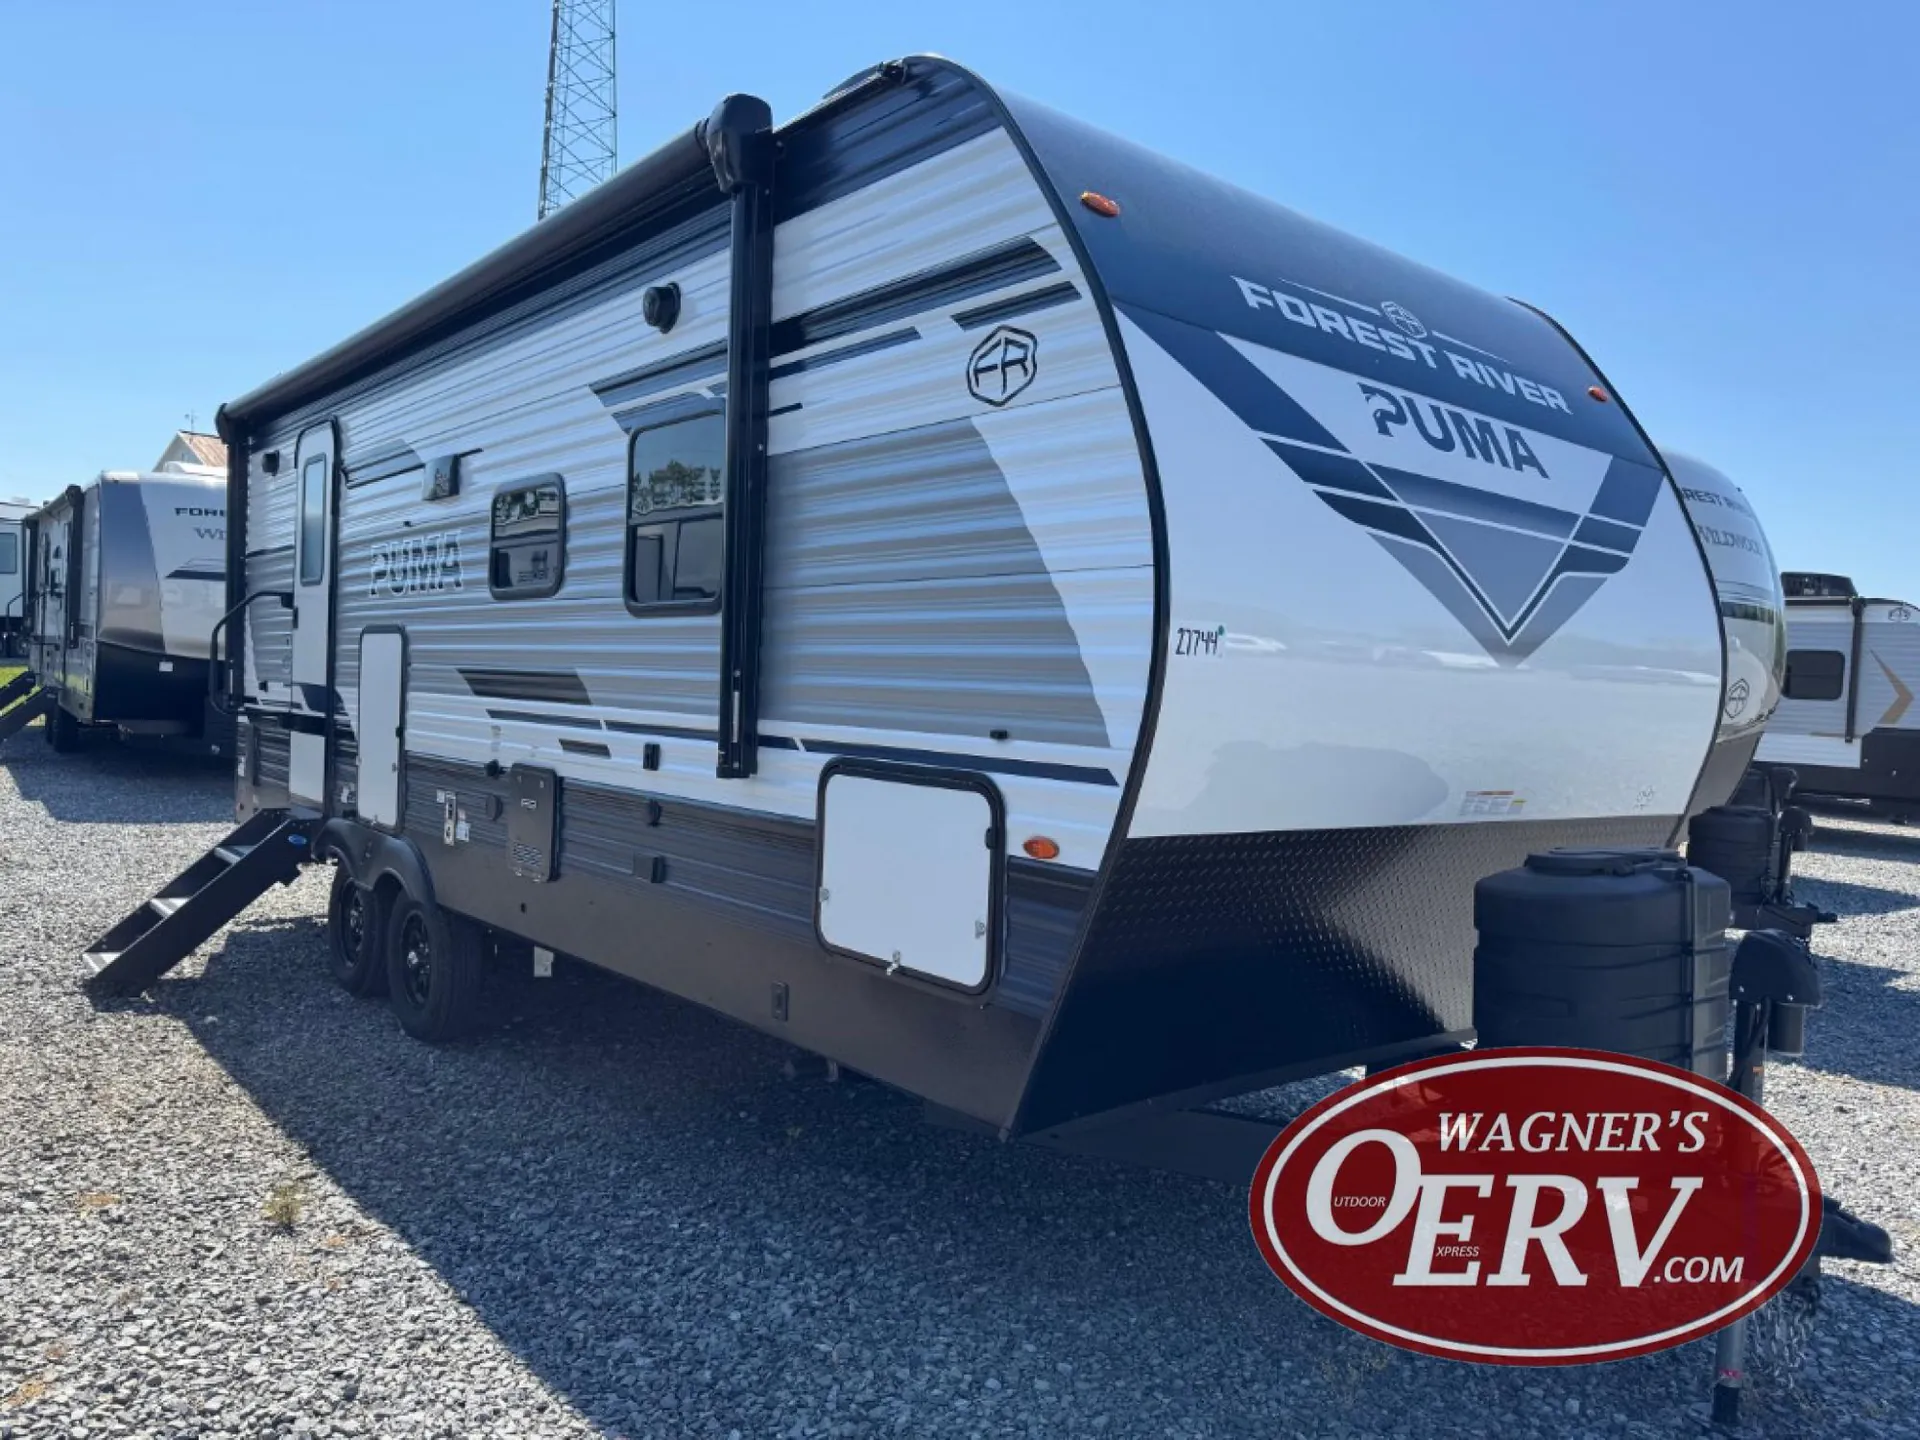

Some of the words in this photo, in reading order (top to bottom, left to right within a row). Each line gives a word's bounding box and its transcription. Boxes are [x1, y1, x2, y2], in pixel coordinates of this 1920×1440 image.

[1230, 276, 1437, 368] FOREST
[1443, 350, 1574, 415] RIVER
[1357, 381, 1550, 480] PUMA
[369, 530, 464, 597] PUMA
[1175, 627, 1218, 656] 27744
